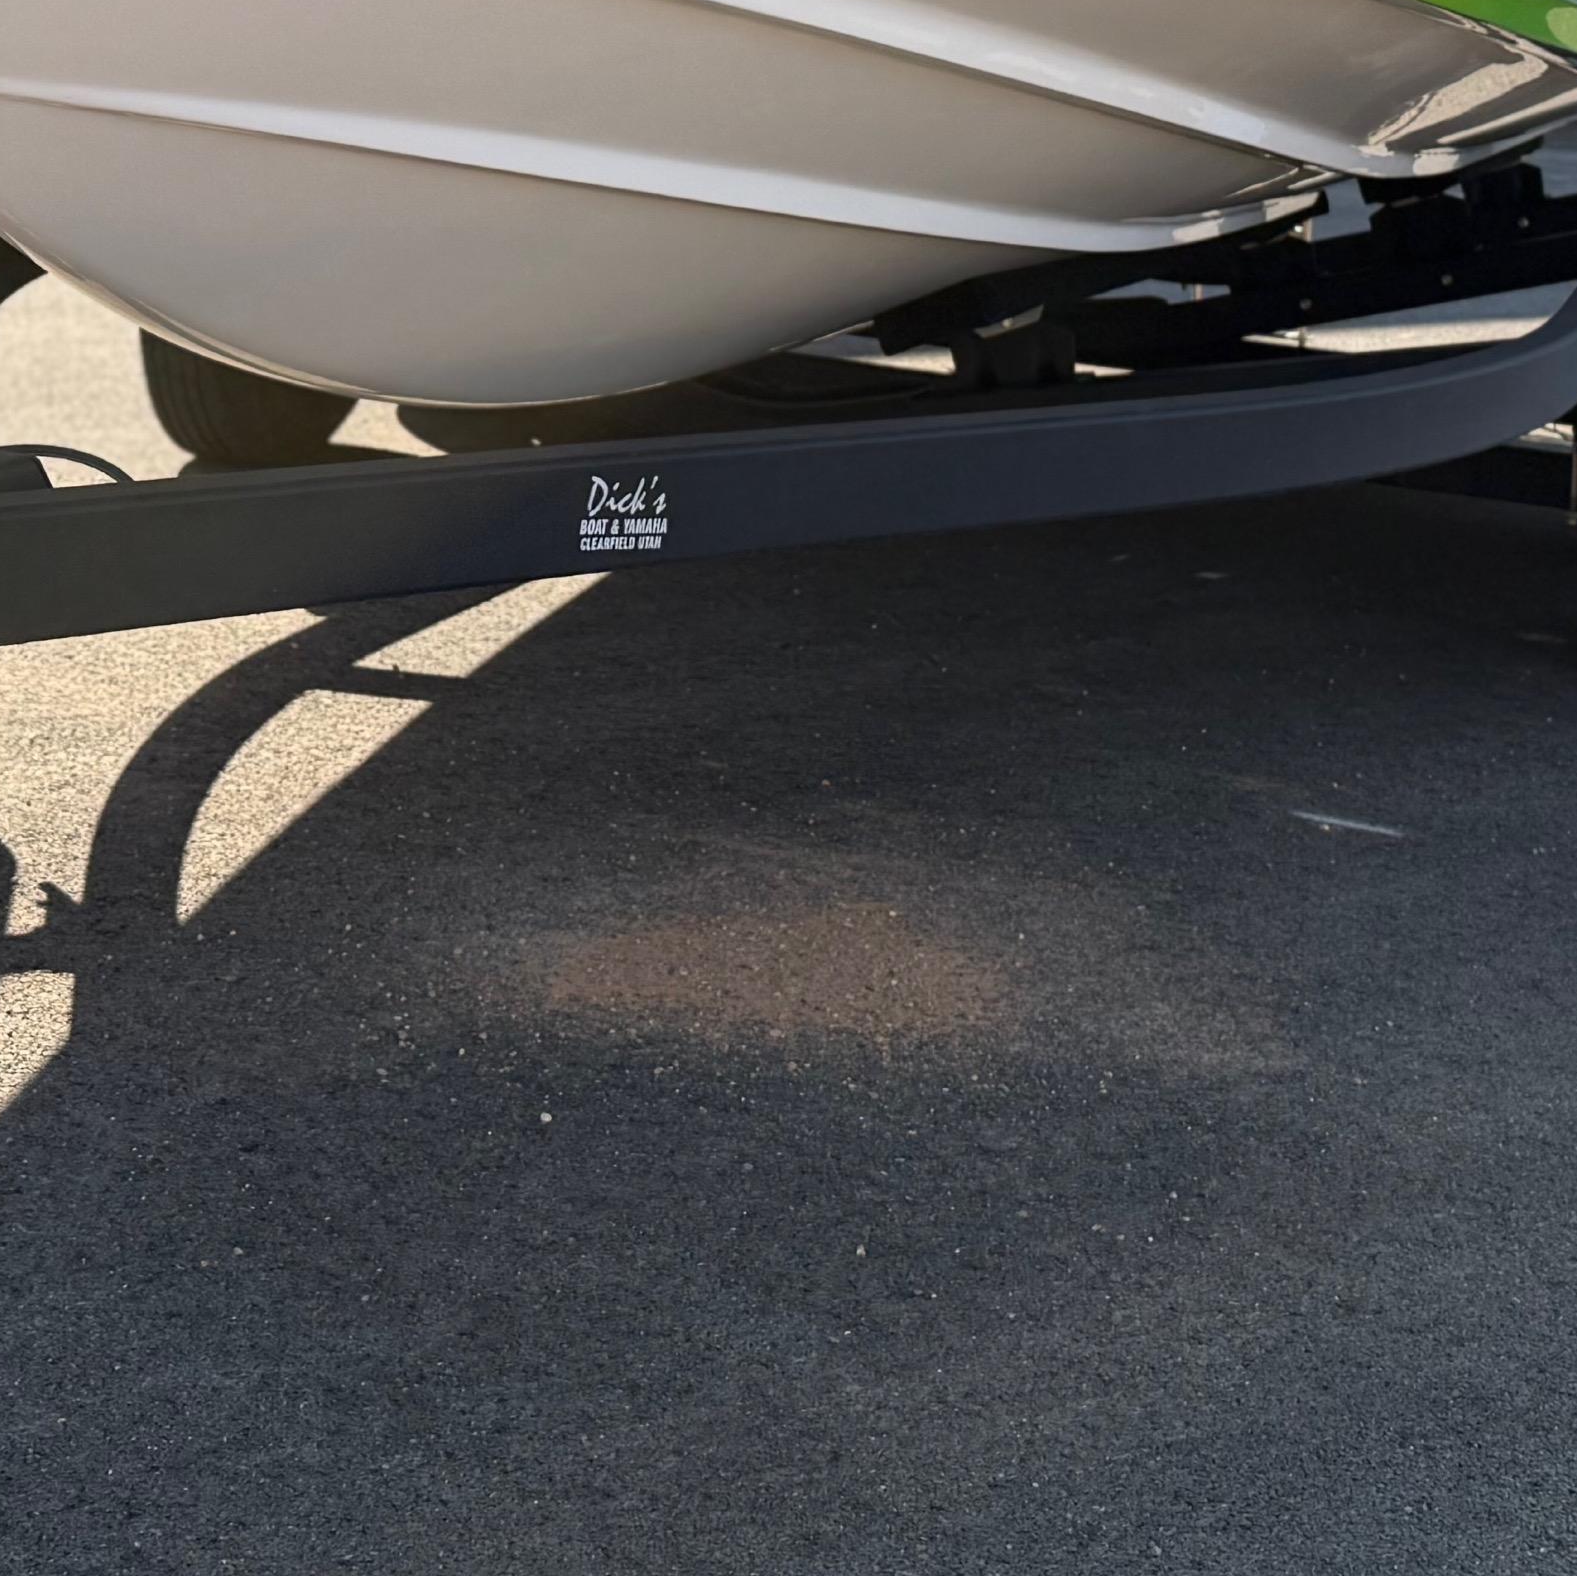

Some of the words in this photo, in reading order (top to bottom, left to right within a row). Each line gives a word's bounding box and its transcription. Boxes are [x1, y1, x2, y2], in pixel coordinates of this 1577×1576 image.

[587, 475, 667, 517] Dick's
[579, 519, 608, 535] BOAT
[610, 519, 619, 535] &
[624, 517, 667, 535] YAMAHA
[580, 536, 635, 551] CLEARFIELD
[637, 535, 662, 549] UTAH
